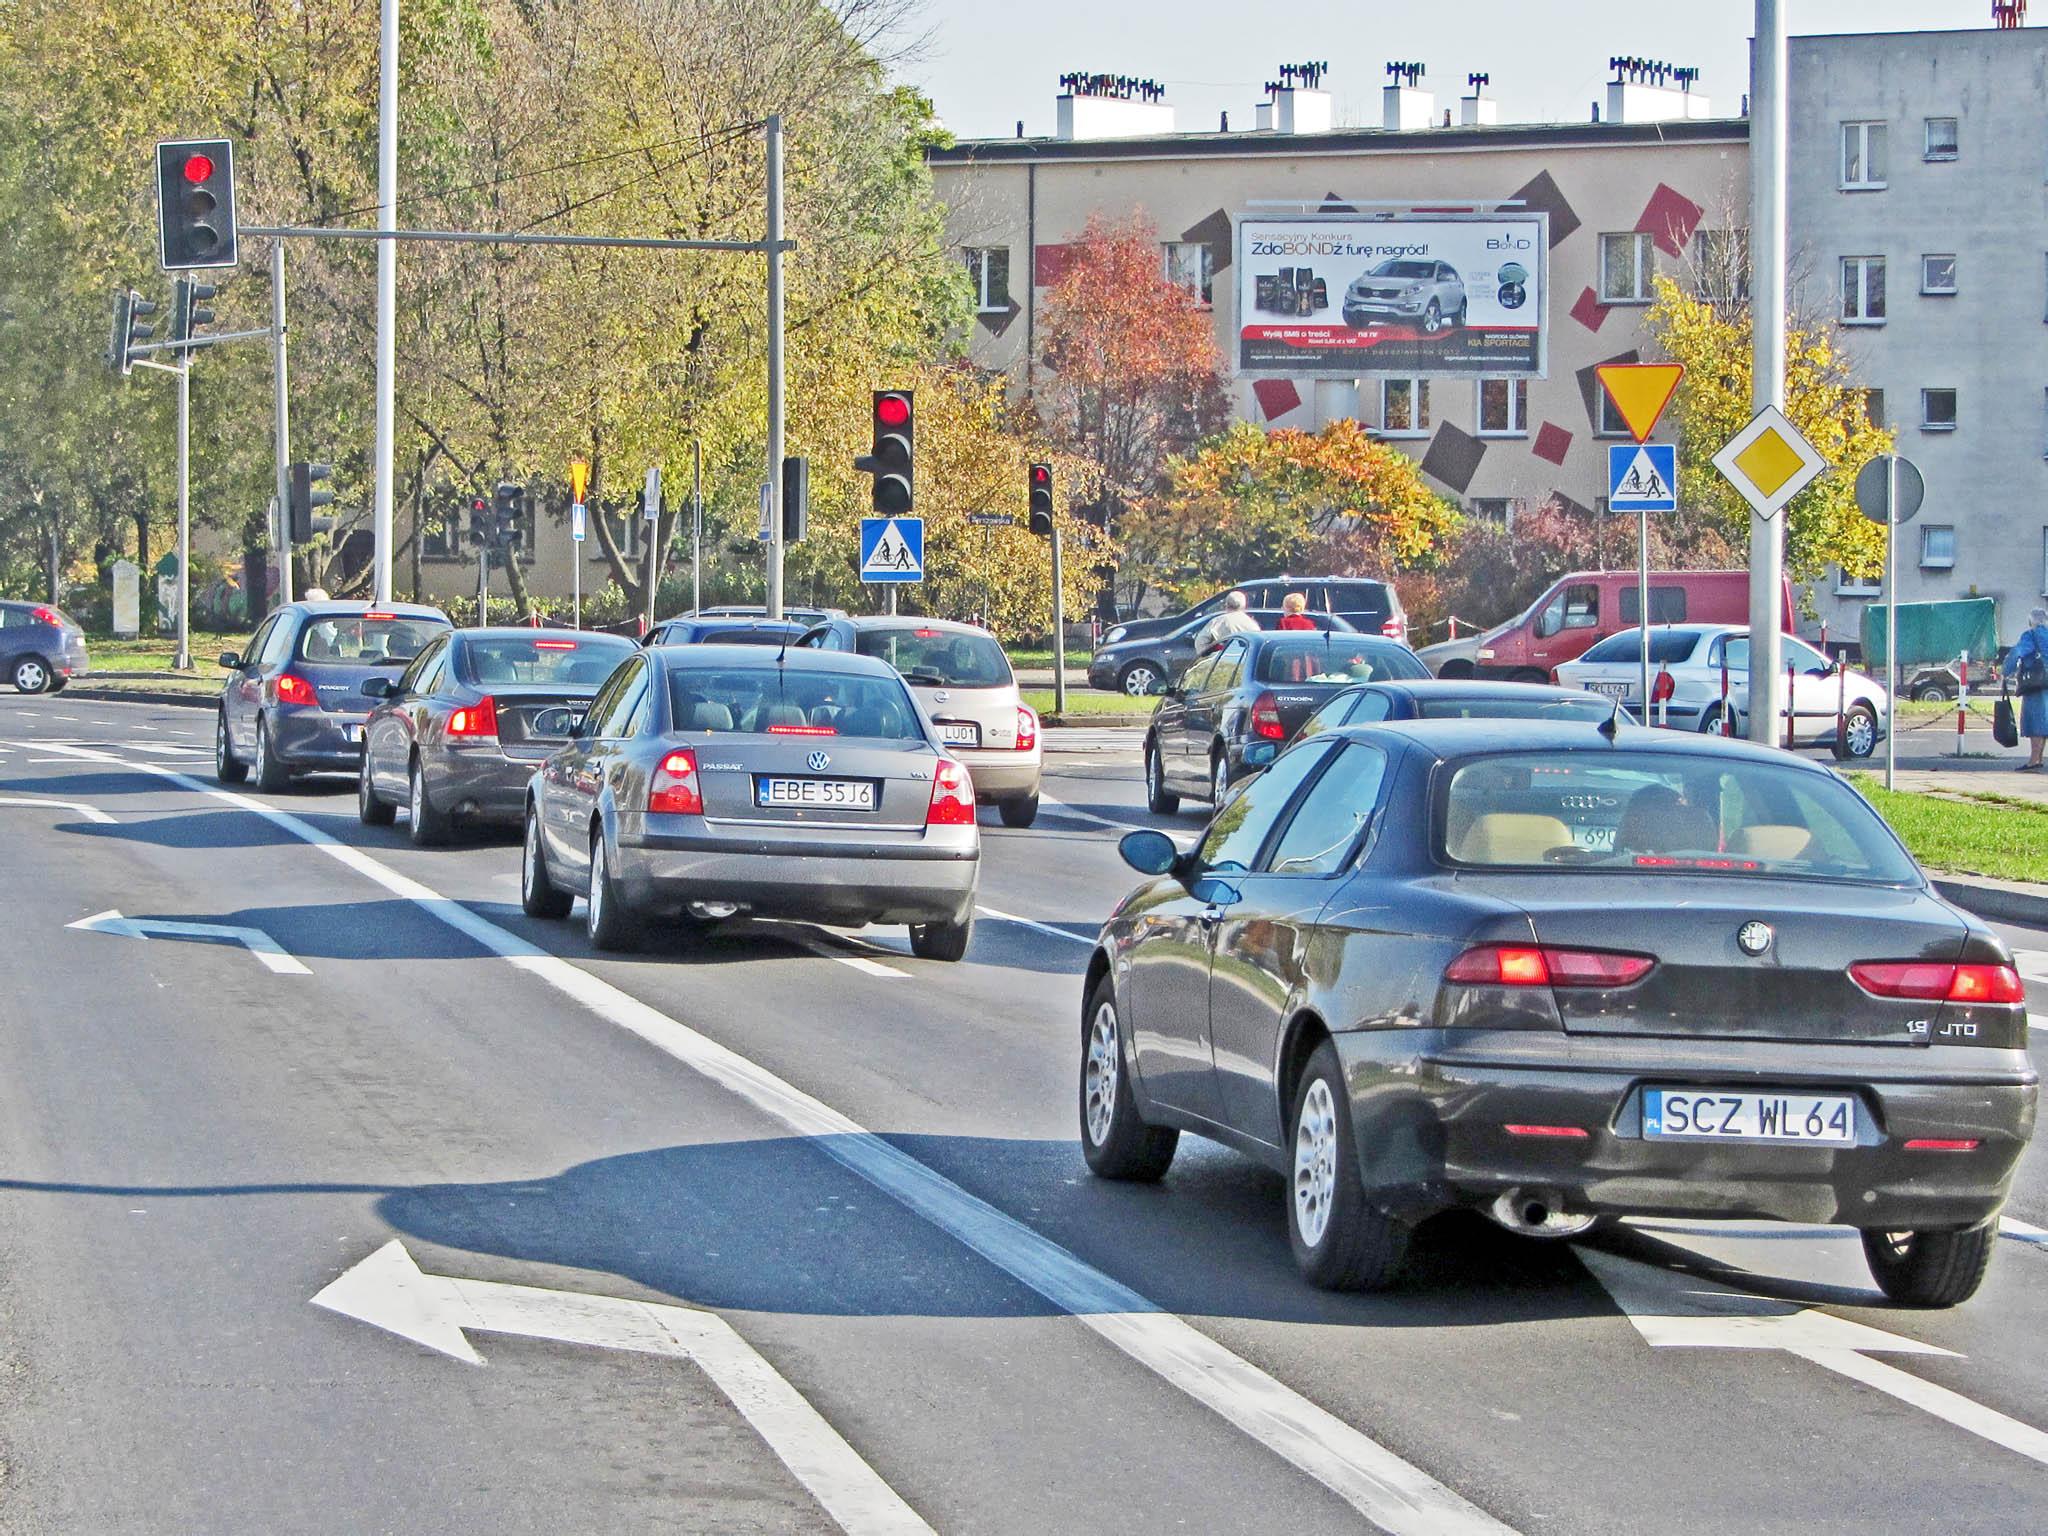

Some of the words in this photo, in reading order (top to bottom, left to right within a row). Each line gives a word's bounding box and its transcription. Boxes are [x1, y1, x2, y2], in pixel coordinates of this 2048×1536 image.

[1251, 232, 1308, 242] Sensacyjny
[1311, 232, 1352, 241] Konkurs
[1346, 243, 1373, 257] furę
[1375, 243, 1429, 258] nagród!
[1467, 339, 1482, 347] KIA
[1484, 339, 1531, 347] SPORTAGE
[702, 762, 743, 770] PASSAT
[773, 781, 815, 801] EBE
[823, 783, 870, 803] 55J6
[1647, 1118, 1660, 1128] PL
[1666, 1096, 1743, 1133] SCZ
[1758, 1098, 1847, 1138] WL64
